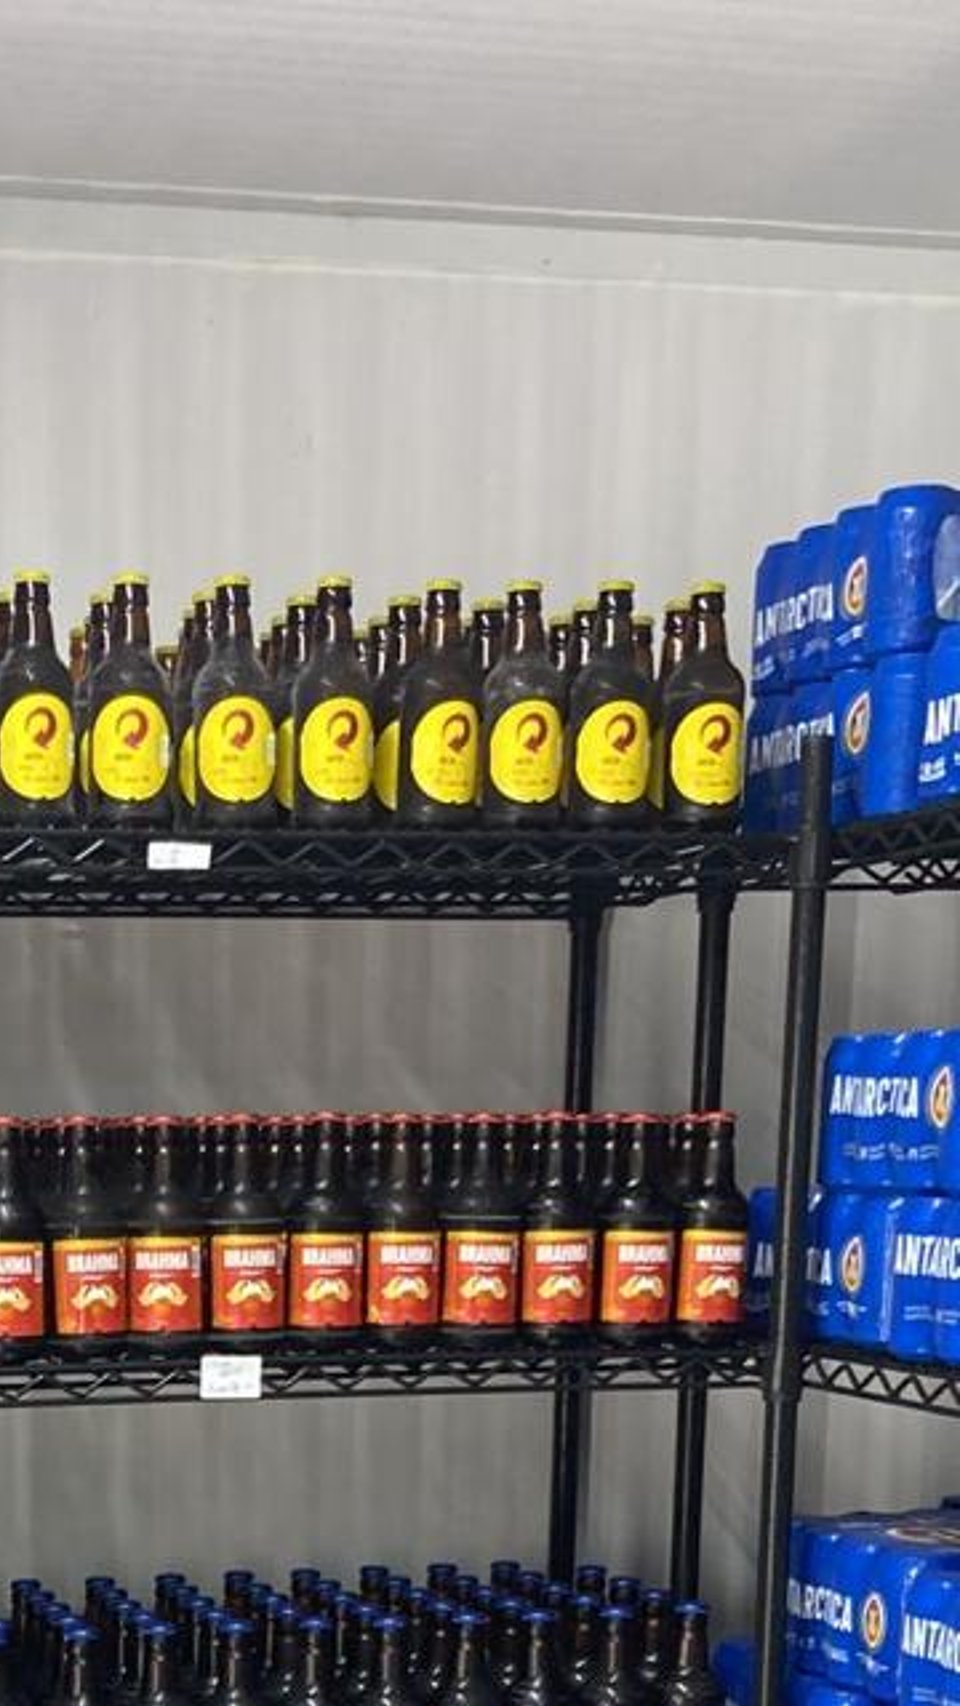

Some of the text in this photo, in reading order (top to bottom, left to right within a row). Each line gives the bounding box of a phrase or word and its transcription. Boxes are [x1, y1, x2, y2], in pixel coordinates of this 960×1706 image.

[829, 1073, 919, 1119] ANTARCTICA
[66, 1252, 119, 1272] BRAHMA
[136, 1251, 189, 1270] BRAHMA
[223, 1248, 277, 1268] BRAHMA
